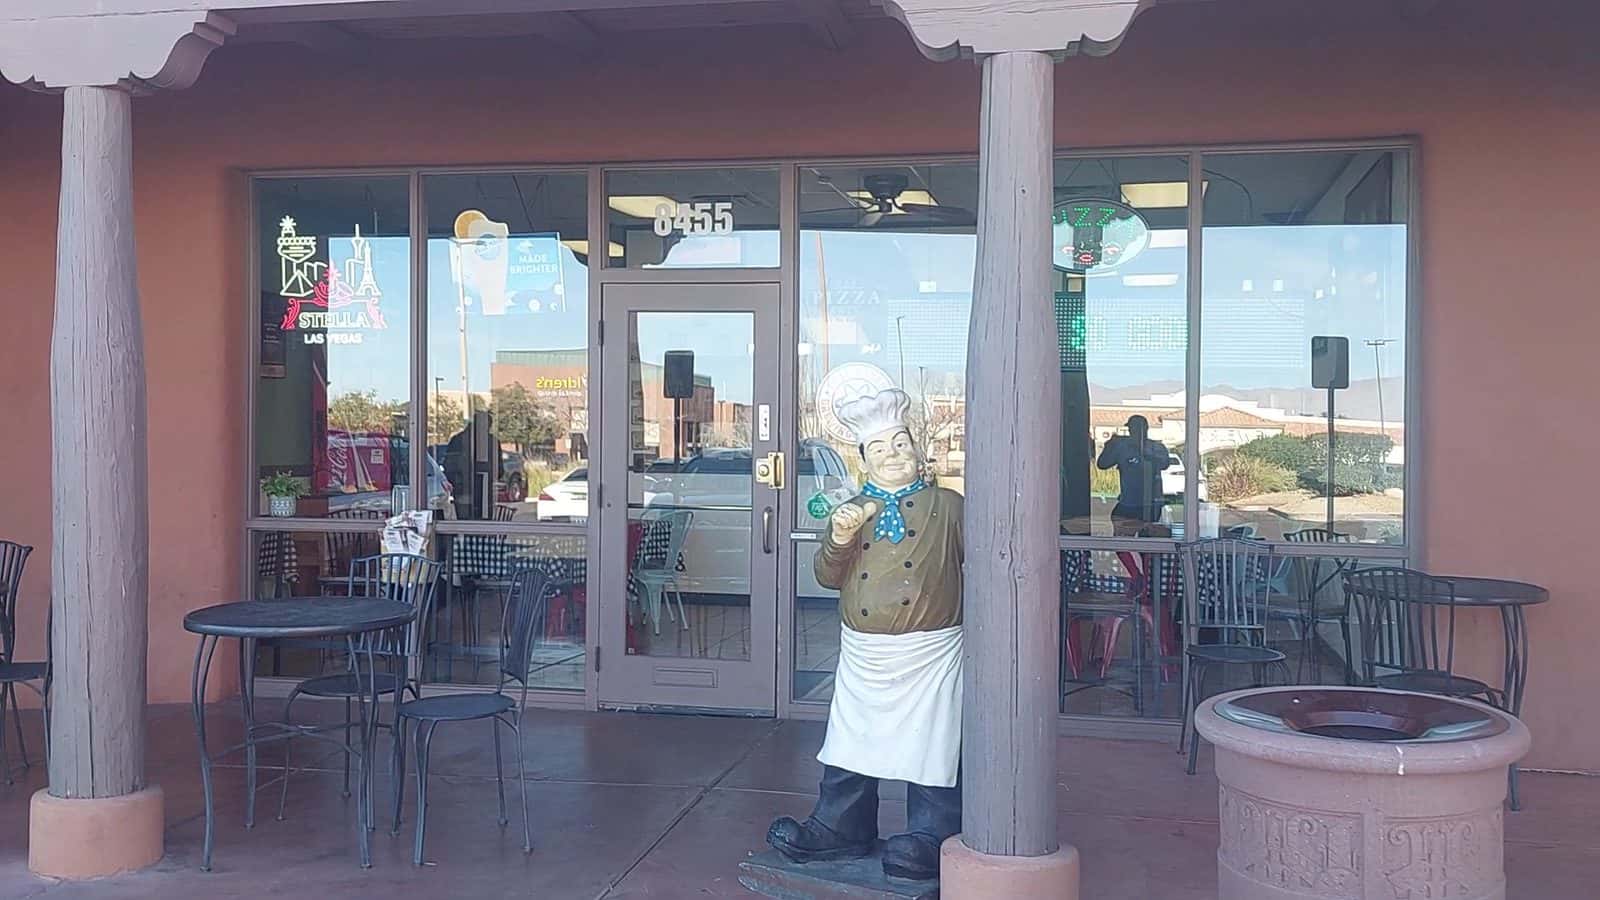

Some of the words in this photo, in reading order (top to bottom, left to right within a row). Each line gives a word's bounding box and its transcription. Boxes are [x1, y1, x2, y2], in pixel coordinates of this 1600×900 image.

[654, 202, 733, 237] 8455
[518, 255, 548, 264] MADE
[298, 311, 371, 329] STELLA
[303, 332, 325, 345] LAS
[326, 332, 363, 345] VEGAS
